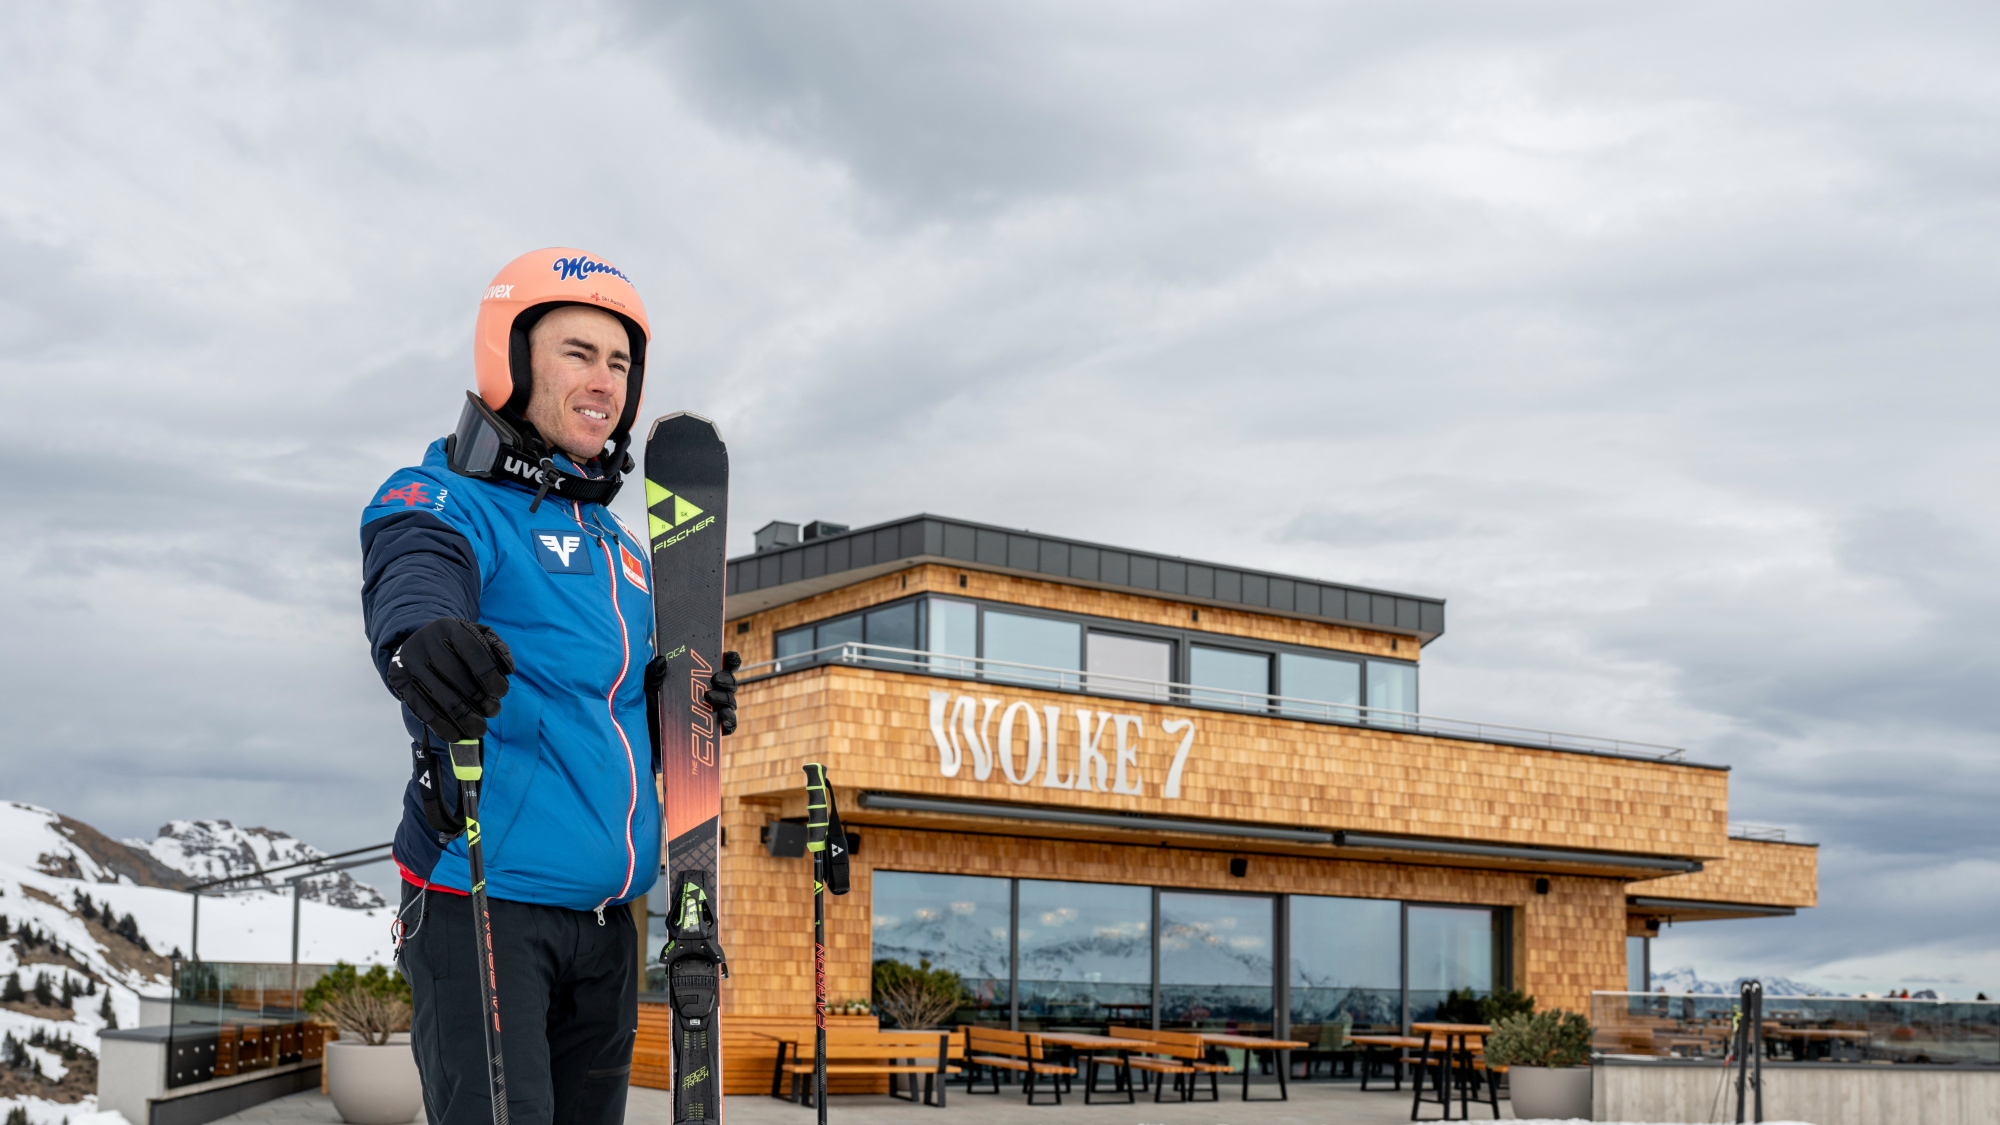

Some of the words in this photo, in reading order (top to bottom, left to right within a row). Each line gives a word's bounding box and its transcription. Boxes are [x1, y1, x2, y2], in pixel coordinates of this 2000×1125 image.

[483, 284, 515, 300] uvex
[654, 516, 715, 553] FISCHER
[928, 690, 1143, 796] WOLKE
[1162, 719, 1195, 798] 7
[815, 942, 826, 1030] CARBON
